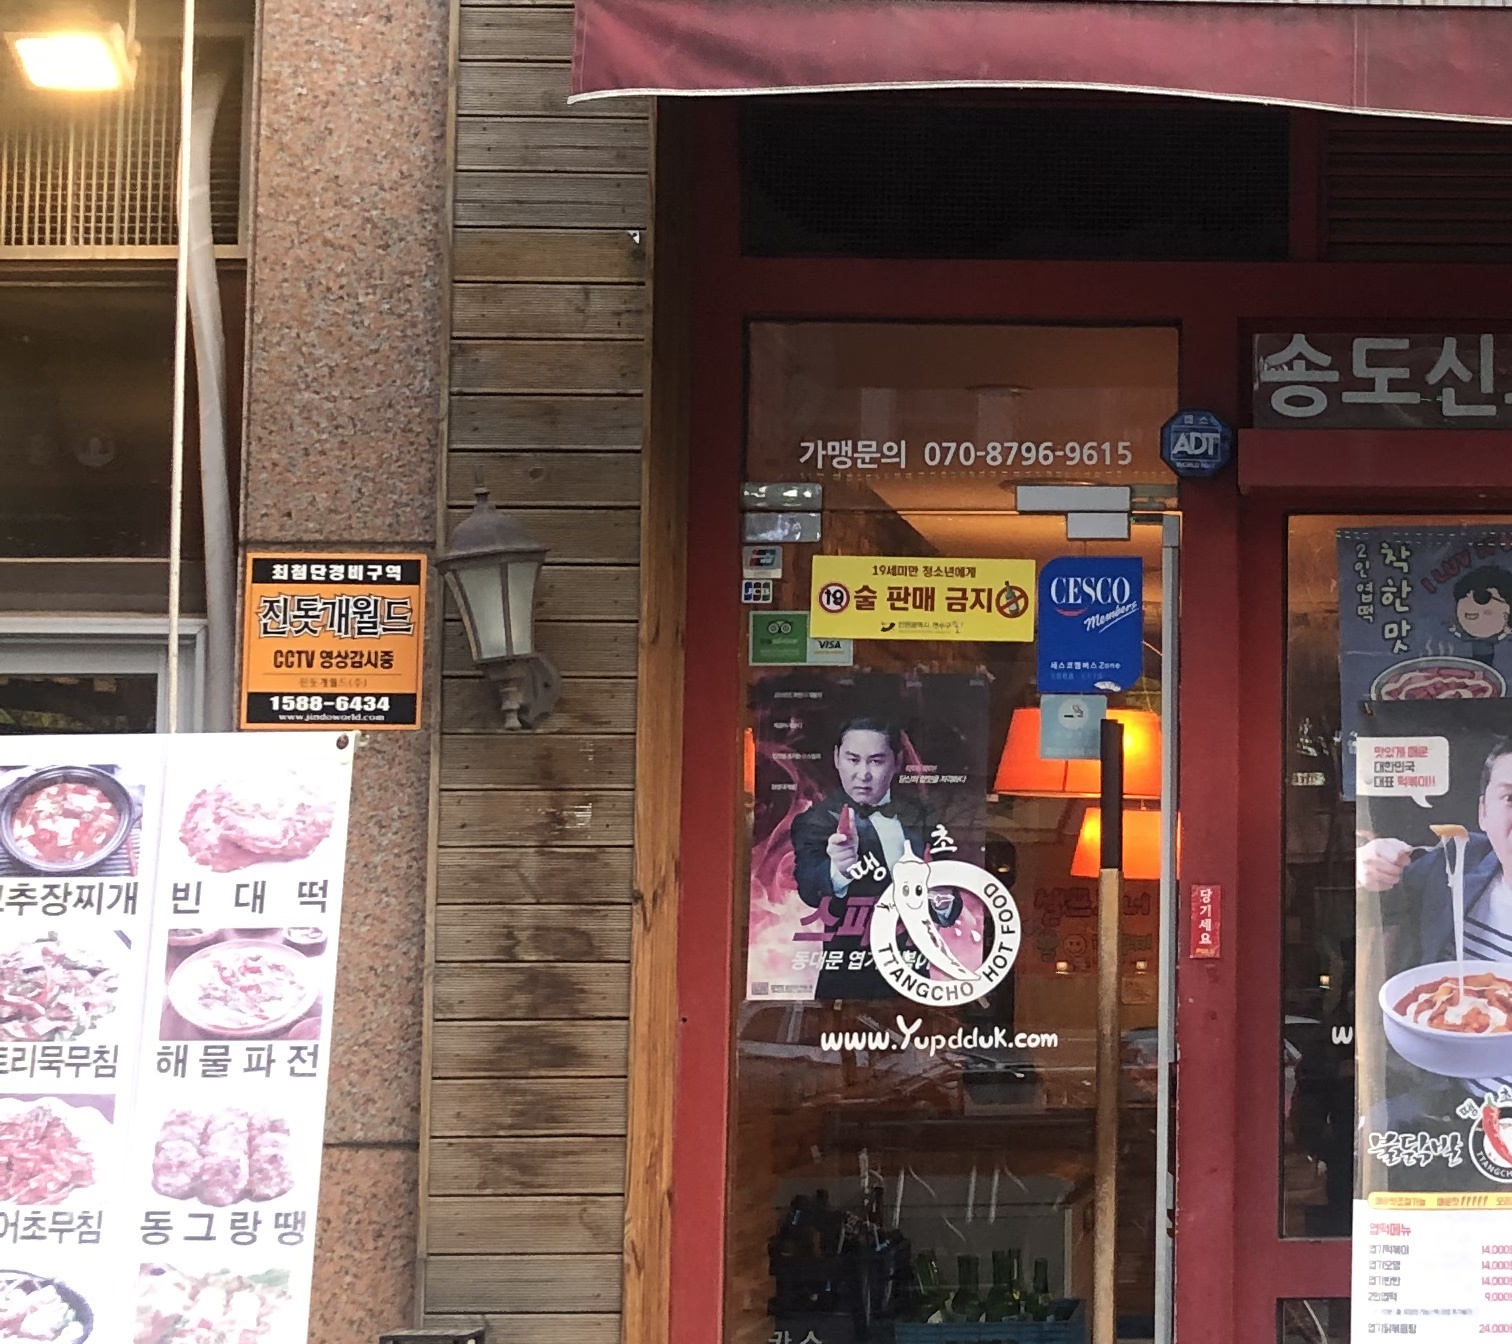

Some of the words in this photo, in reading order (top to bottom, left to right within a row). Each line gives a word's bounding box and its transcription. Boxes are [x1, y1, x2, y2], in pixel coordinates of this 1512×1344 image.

[799, 440, 906, 470] 가맹문의
[924, 440, 1133, 467] 070-8796-9615
[1171, 431, 1220, 456] ADT
[272, 563, 402, 581] 최첨단경비구역
[824, 588, 845, 606] 19
[854, 585, 878, 612] 술
[886, 586, 936, 613] 판매
[945, 587, 993, 613] 금지
[1050, 576, 1131, 605] CESCO
[256, 593, 415, 640] 진돗개월드
[818, 640, 842, 649] VISA
[273, 649, 315, 669] CCTV
[320, 650, 395, 669] 영상감시중
[270, 695, 391, 712] 1588-6434
[278, 713, 385, 723] www.jindoworld.com
[1373, 761, 1416, 773] 대한민국
[1373, 775, 1395, 788] 대표
[0, 880, 139, 916] 추장찌개
[984, 883, 1018, 935] FOOD
[1198, 888, 1214, 947] 당기세요
[877, 942, 976, 1003] TTANGCHO
[982, 942, 1014, 981] HOT
[820, 1015, 1059, 1057] www.Yupdduk.com
[0, 1044, 119, 1079] 리묵무침
